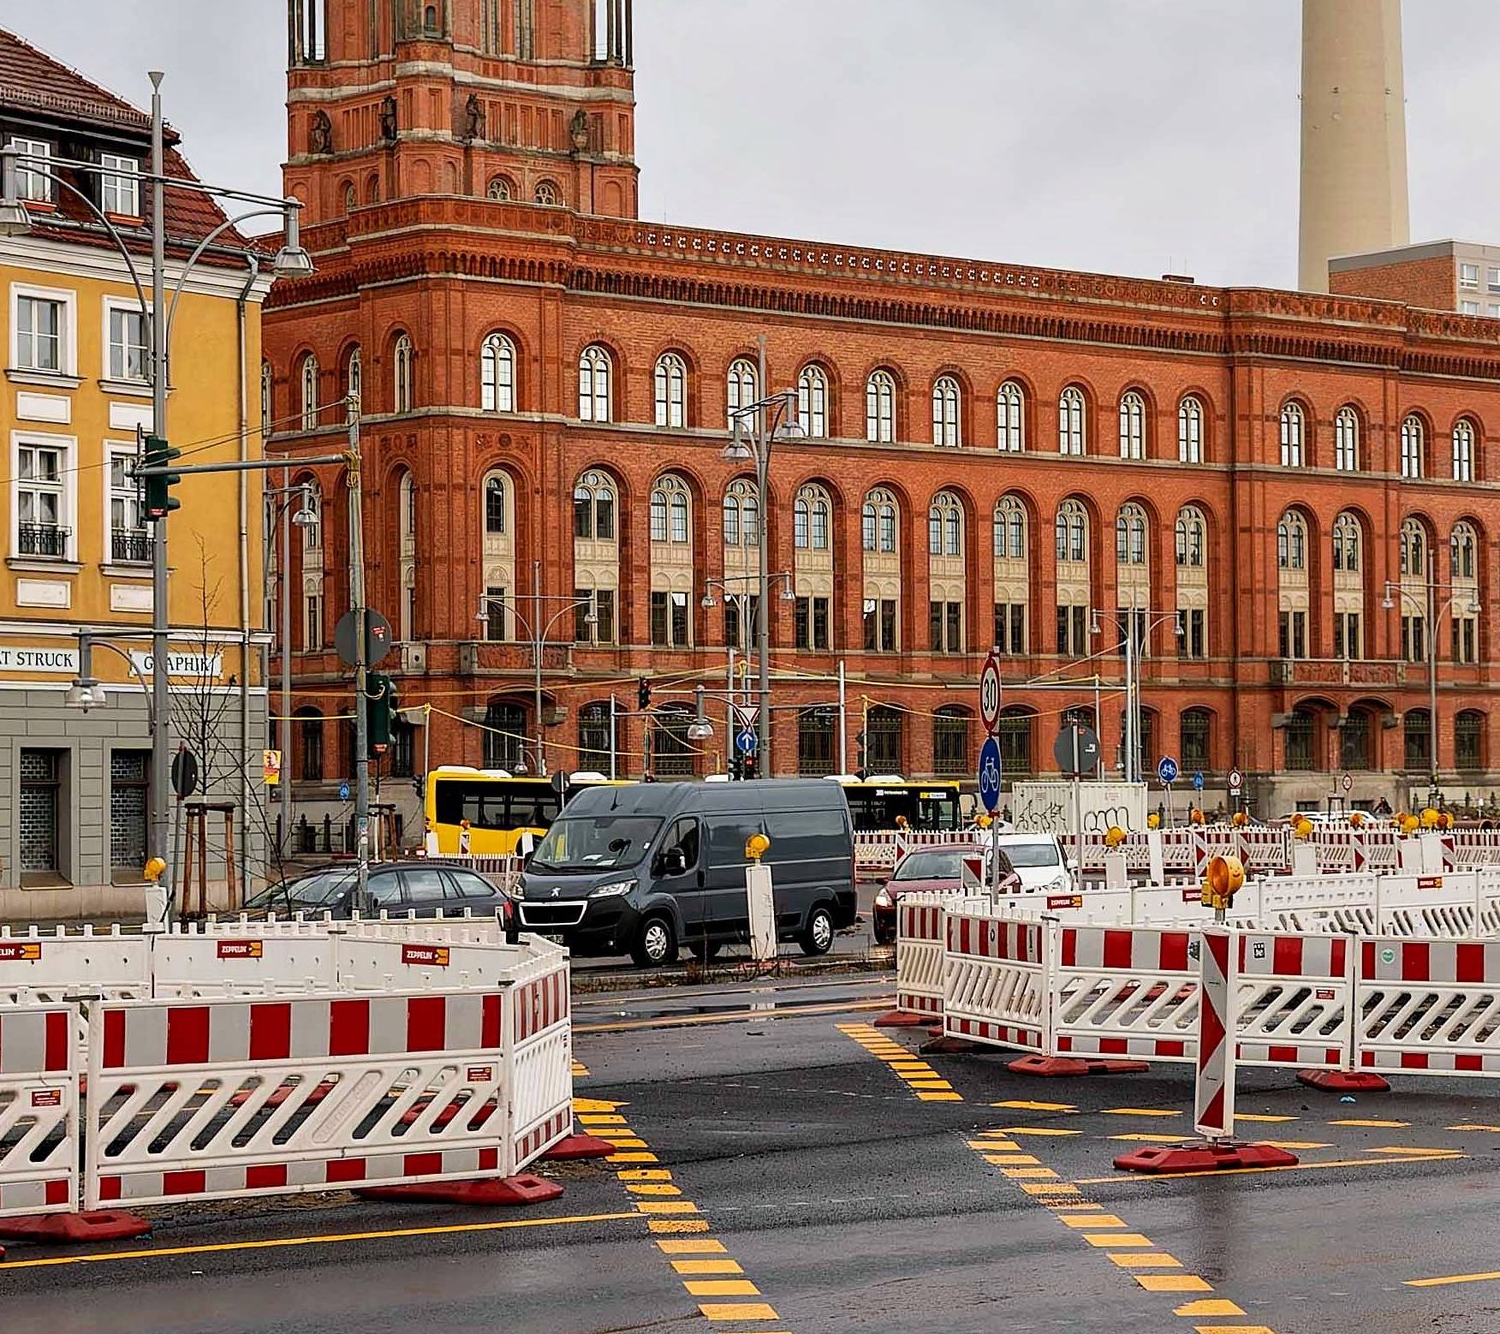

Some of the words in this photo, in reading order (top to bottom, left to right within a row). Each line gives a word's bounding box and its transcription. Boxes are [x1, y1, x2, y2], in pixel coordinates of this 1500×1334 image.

[16, 651, 74, 668] STRUCK
[143, 655, 211, 672] GAPHIK
[983, 678, 997, 712] 30
